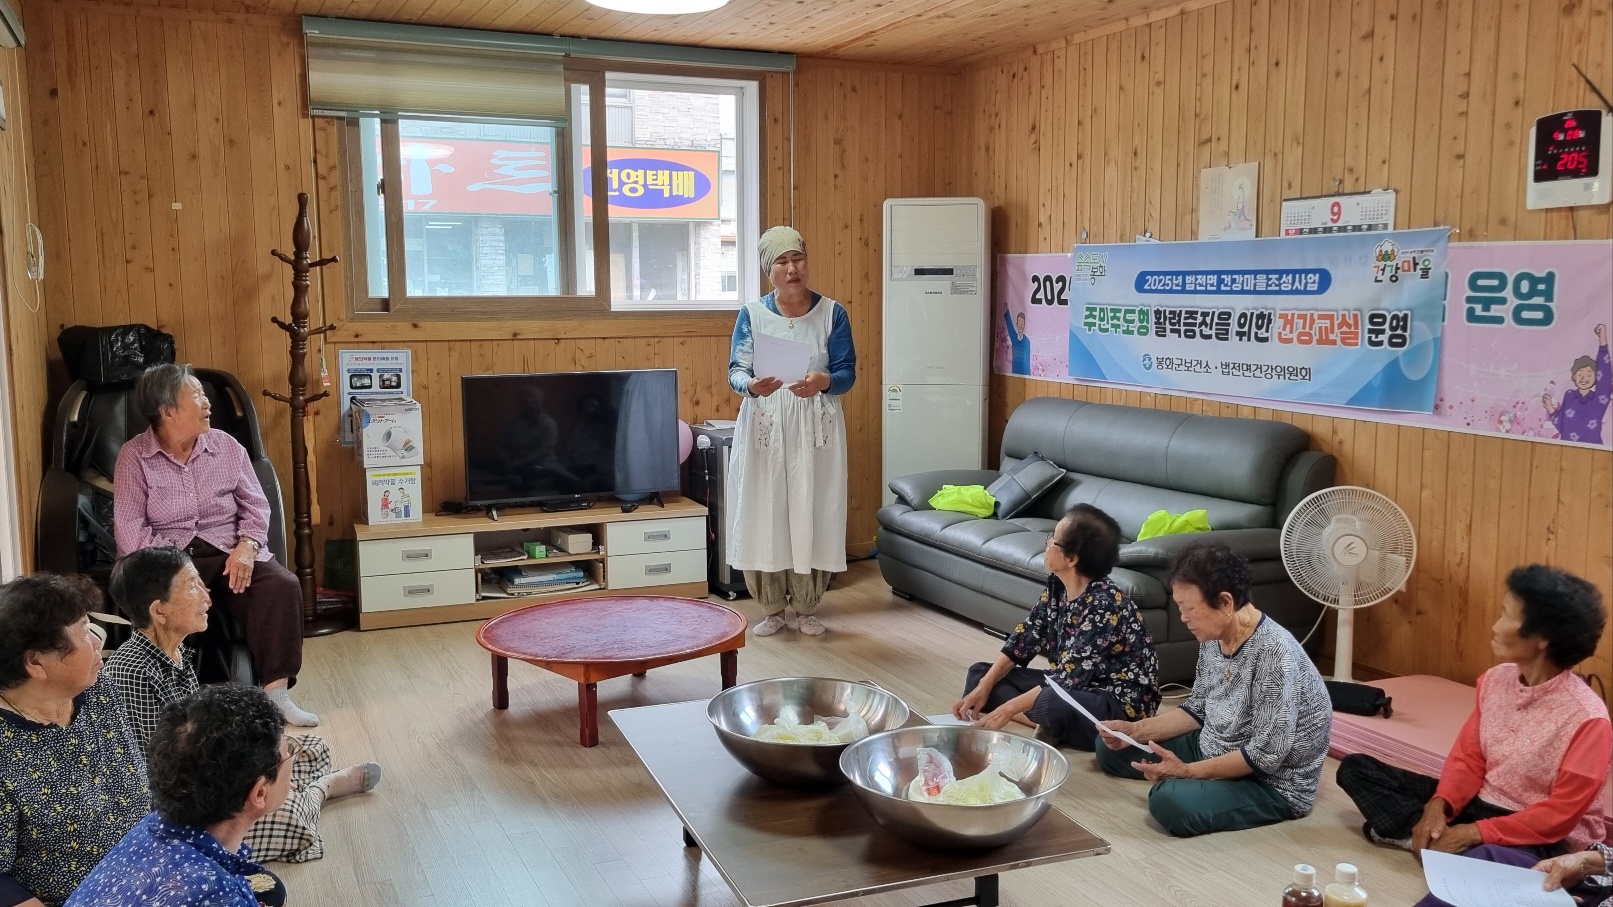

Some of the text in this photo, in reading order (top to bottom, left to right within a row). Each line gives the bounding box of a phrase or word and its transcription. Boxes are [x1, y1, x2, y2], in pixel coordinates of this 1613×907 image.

[1329, 202, 1342, 224] 9
[1090, 264, 1106, 285] 봉화
[1144, 273, 1320, 292] 2025년 법전면 건강마을조성사업
[1373, 256, 1432, 283] 건강마을
[1030, 274, 1072, 306] 202
[1465, 271, 1556, 327] 운영
[1083, 306, 1409, 348] 주민주도형 활력증진을 위한 건강교실 운영
[1155, 356, 1312, 382] 봉화군보건소 법전면건강위원회
